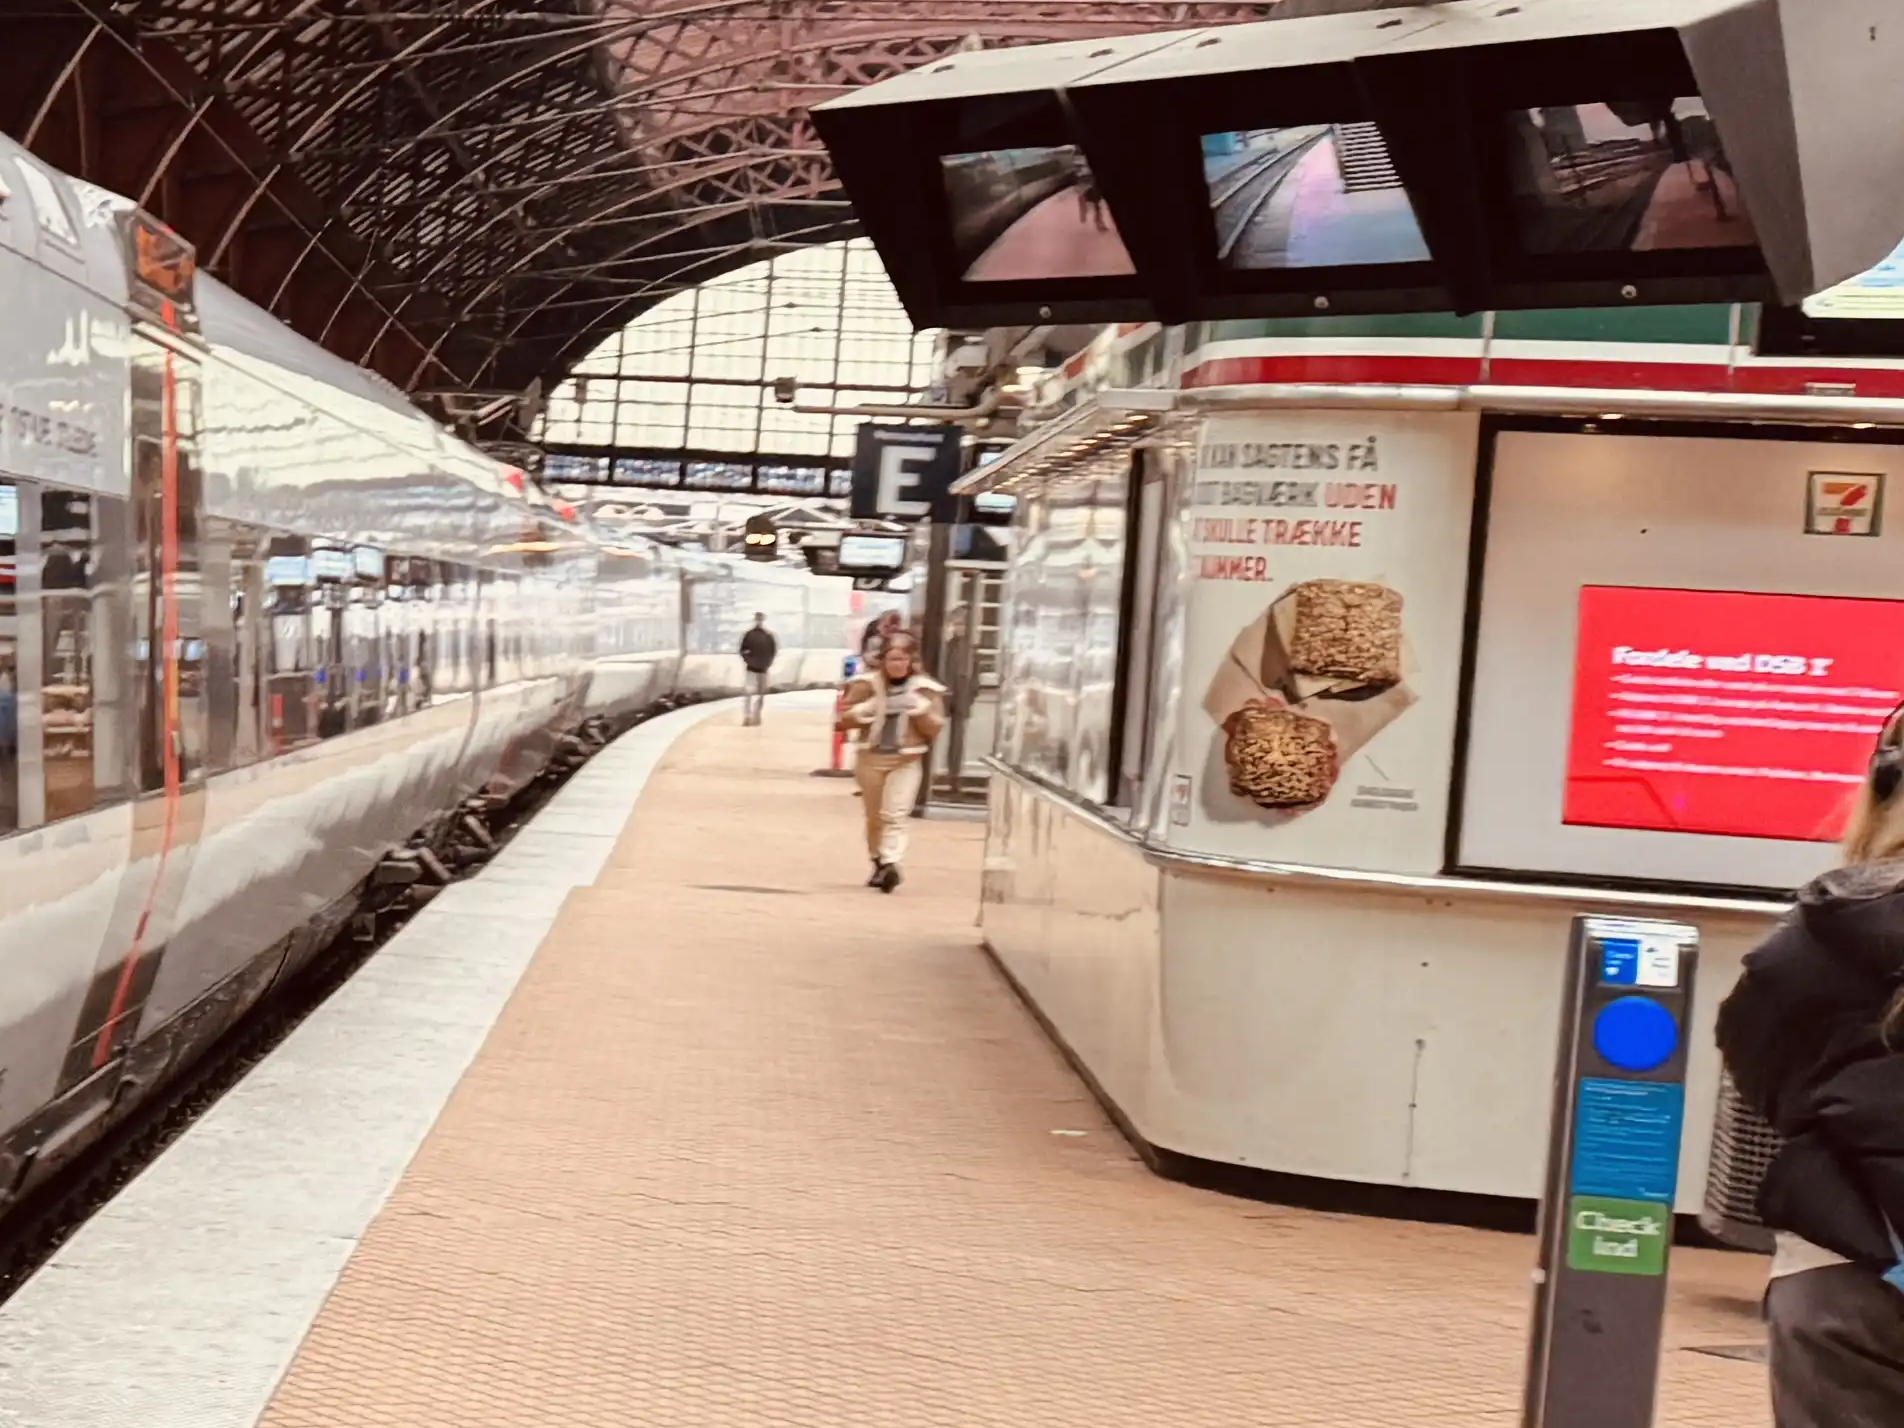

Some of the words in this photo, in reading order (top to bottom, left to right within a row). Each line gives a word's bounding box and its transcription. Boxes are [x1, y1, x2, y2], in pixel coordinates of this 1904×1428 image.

[1242, 441, 1341, 471] SAGTENS
[1345, 435, 1380, 472] FÅ
[876, 445, 937, 516] E
[1325, 482, 1398, 511] UDEN
[1263, 518, 1364, 548] TRÆKKE
[1575, 1210, 1663, 1237] Check
